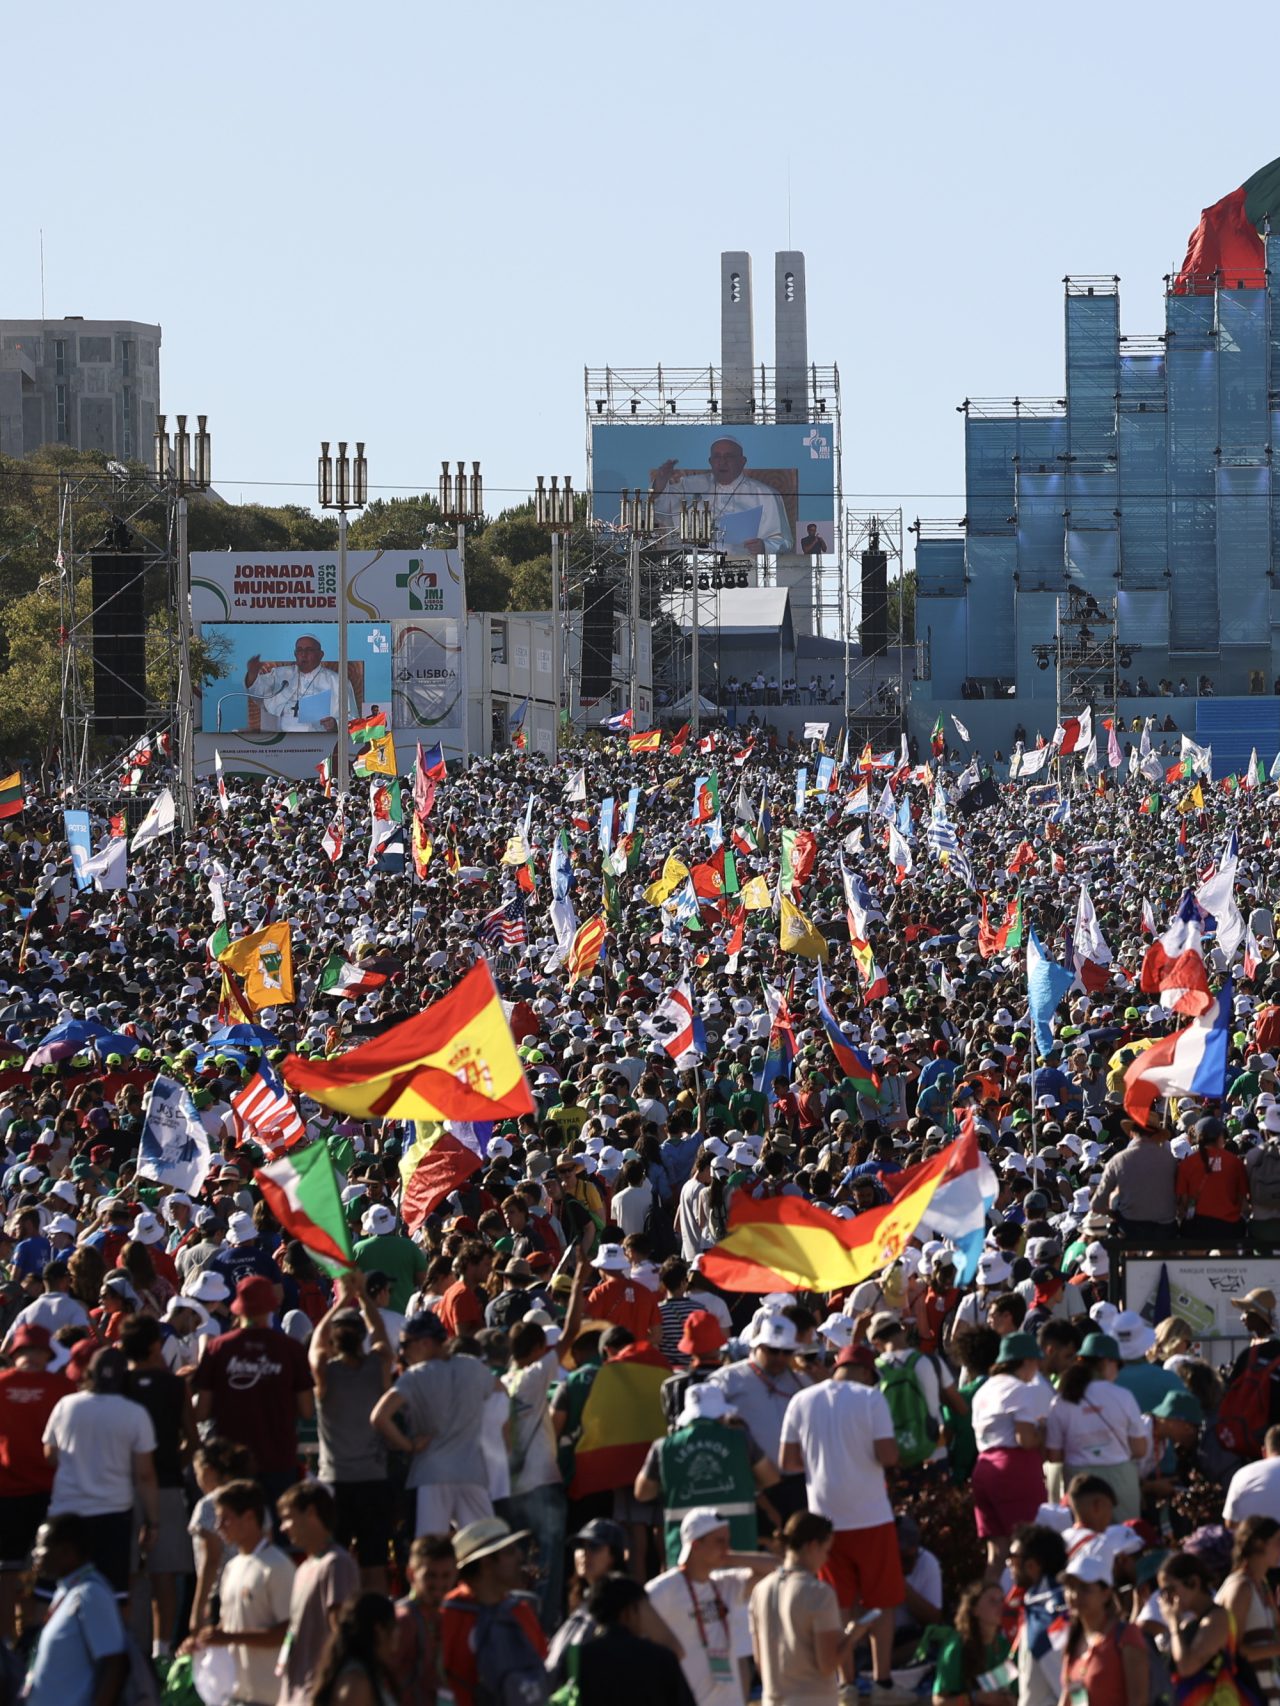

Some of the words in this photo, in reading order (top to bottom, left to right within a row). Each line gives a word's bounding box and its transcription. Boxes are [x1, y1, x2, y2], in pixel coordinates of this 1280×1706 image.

[235, 565, 315, 578] JORNADA
[326, 564, 336, 593] 2023
[234, 581, 315, 594] MUNDIAL
[424, 589, 443, 599] JMJ
[234, 598, 247, 607] da
[250, 596, 337, 609] JUVENTUDE
[416, 669, 456, 679] LISBOA
[674, 1440, 730, 1463] LEBANON
